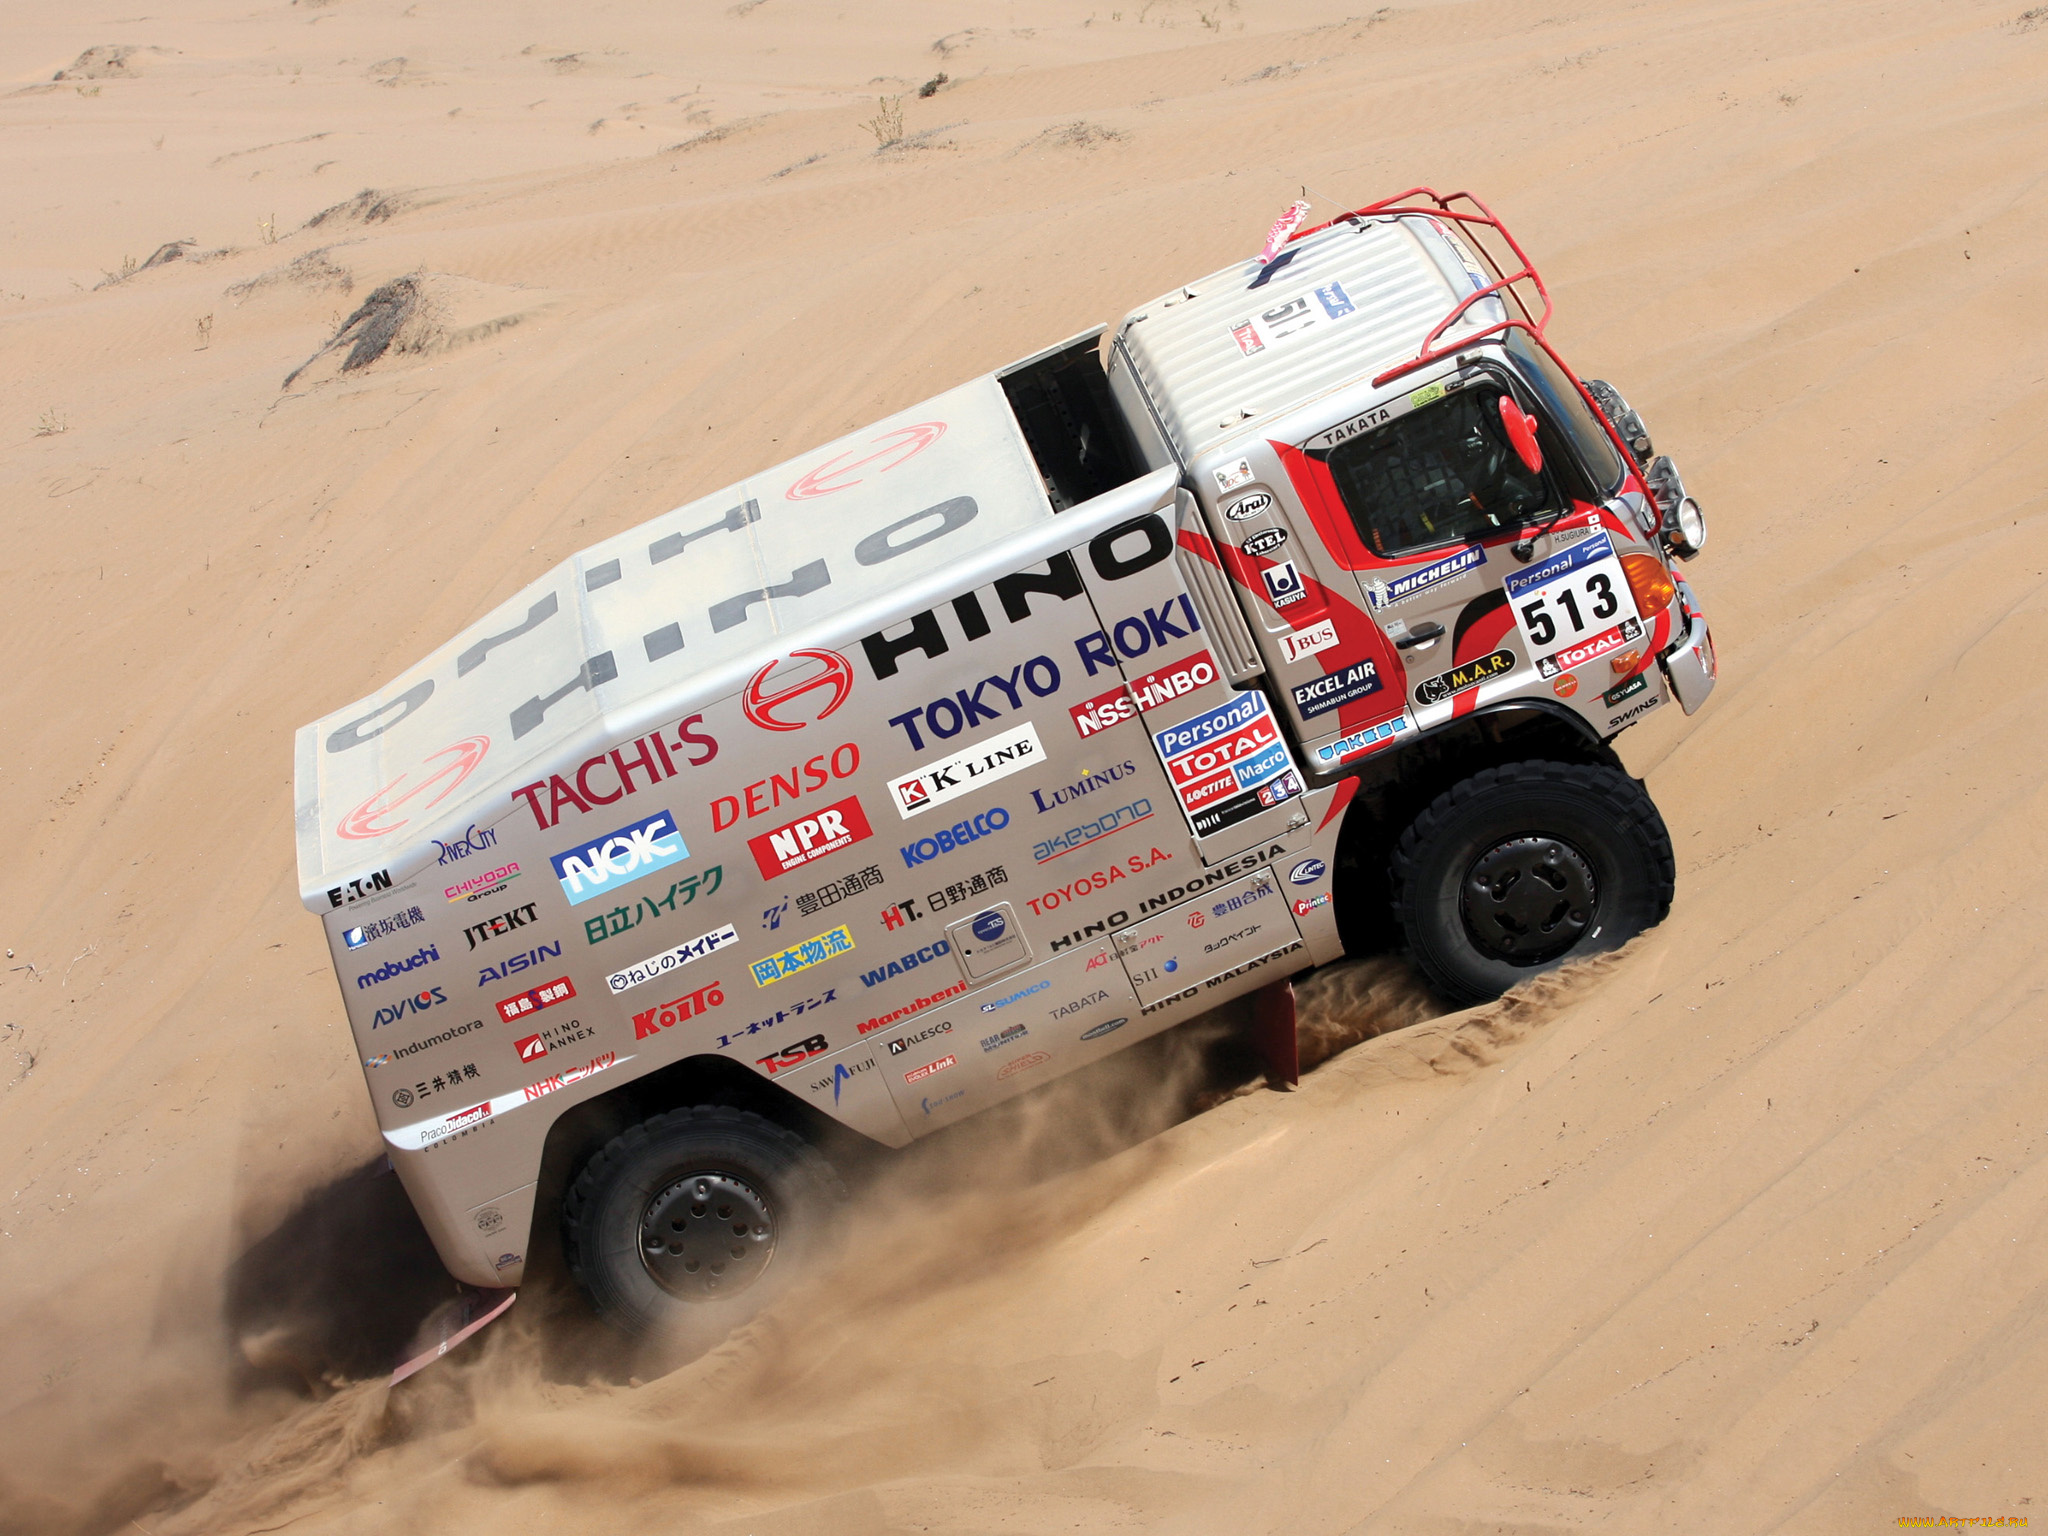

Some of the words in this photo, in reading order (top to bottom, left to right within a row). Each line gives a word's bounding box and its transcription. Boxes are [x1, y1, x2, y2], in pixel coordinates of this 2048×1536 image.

[1323, 408, 1391, 444] TAKATA
[1230, 494, 1266, 519] Arai
[1244, 532, 1286, 555] KTEL
[1582, 536, 1607, 553] Personal
[1394, 550, 1480, 596] MICHELIN
[1510, 555, 1573, 592] Personal
[860, 514, 1174, 681] HINO
[1274, 591, 1307, 609] KASUYA
[1520, 572, 1618, 646] 513
[1558, 634, 1622, 665] TOTAL
[888, 655, 1061, 752] TOKYO
[1074, 592, 1201, 677] ROKI
[1295, 676, 1344, 705] EXCEL
[1346, 661, 1376, 685] AIR
[1452, 654, 1511, 688] M.A.R.
[1620, 681, 1642, 697] YUASA
[1076, 662, 1214, 737] NISSHINBO
[1307, 693, 1348, 714] SHIMABUN
[1348, 682, 1373, 698] GROUP
[1609, 696, 1658, 727] SWANS
[1164, 697, 1259, 753] Personal
[511, 714, 719, 831] TACHI-S
[966, 739, 1034, 778] LINE
[1172, 729, 1273, 776] TOTAL
[1239, 750, 1285, 782] Macro
[709, 743, 861, 833] DENSO
[1029, 760, 1136, 815] LUMINUS
[1186, 775, 1234, 804] LOCTITE
[769, 809, 850, 862] NPR
[900, 807, 1010, 869] KOBELCO
[1033, 798, 1152, 861] akebono
[559, 819, 678, 894] NOK
[781, 851, 807, 870] ENGINE
[805, 834, 853, 862] COMPONENTS
[1304, 861, 1325, 875] LINTEC
[444, 862, 520, 899] CHIYODA
[467, 884, 508, 903] Group
[795, 864, 885, 918] 豊田通商
[927, 865, 1010, 912] 日野通商
[1026, 865, 1126, 916] TOYOSA
[1127, 847, 1173, 875] S.A.
[1050, 910, 1130, 952] HINO
[1139, 843, 1287, 914] INDONESIA
[584, 865, 724, 945] 日立ハイテク
[1297, 894, 1330, 914] Printec
[462, 903, 540, 951] JTEKT
[357, 944, 441, 989] mabuchi
[478, 940, 562, 988] AISIN
[628, 929, 736, 984] ねじのメイドー
[751, 930, 853, 985] 岡本物流
[859, 939, 950, 988] WABCO
[1133, 967, 1159, 987] SII
[994, 979, 1051, 1009] SUMICO
[1140, 987, 1198, 1016] HINO
[1205, 942, 1304, 989] MALAYSIA
[856, 980, 967, 1036] Marubeni
[1049, 989, 1110, 1021] TABATA
[393, 1019, 484, 1060] Indumotora
[542, 1019, 580, 1040] HINO
[549, 1027, 596, 1052] ANNEX
[905, 1021, 952, 1049] ALESCO
[756, 1033, 829, 1074] TSB
[928, 1056, 955, 1075] Link
[415, 1063, 481, 1099] 三井精機
[424, 1118, 496, 1153] COLOMBIA
